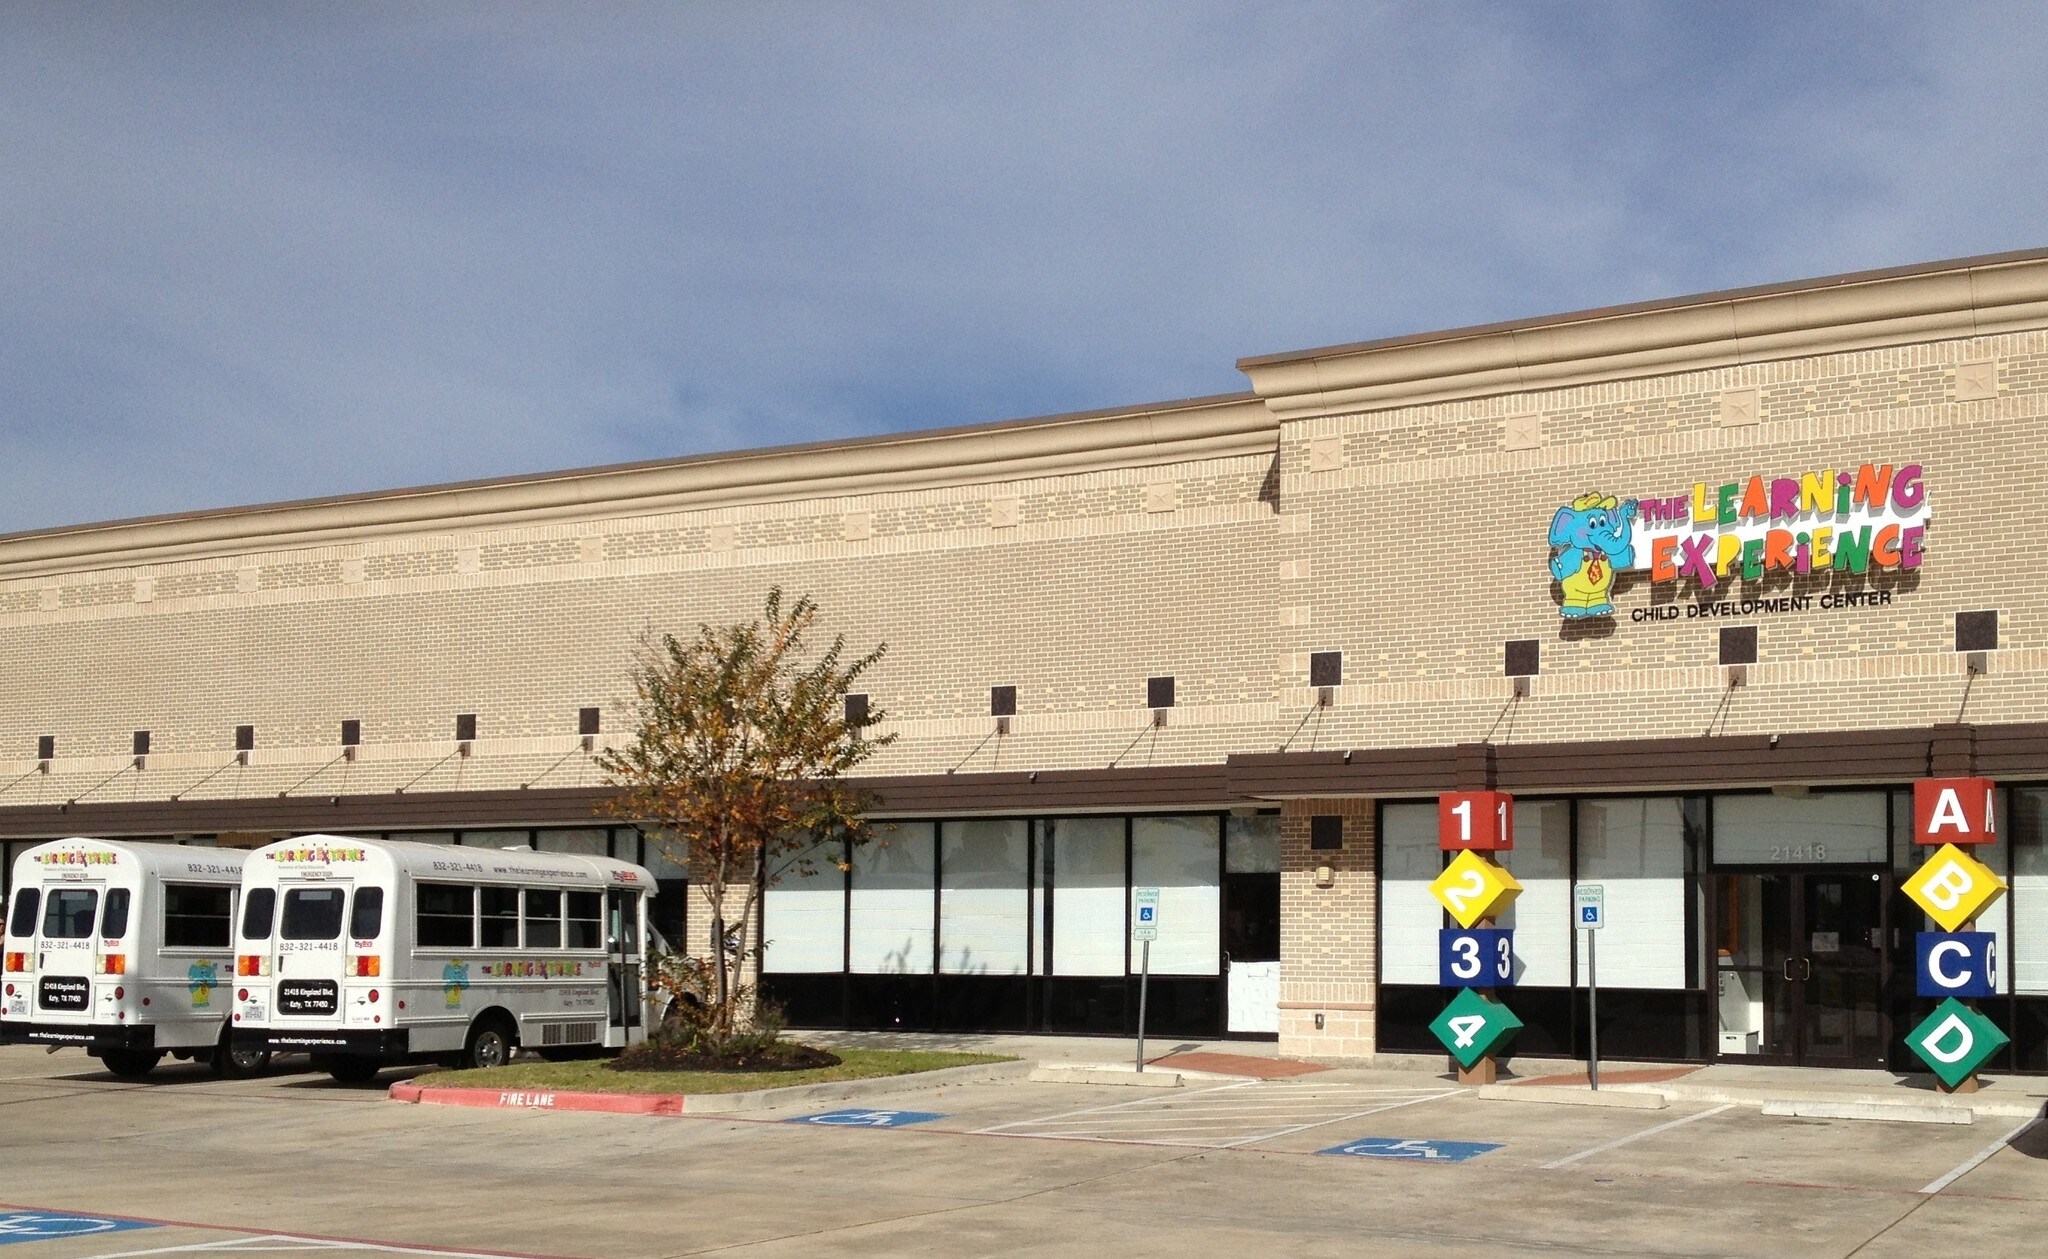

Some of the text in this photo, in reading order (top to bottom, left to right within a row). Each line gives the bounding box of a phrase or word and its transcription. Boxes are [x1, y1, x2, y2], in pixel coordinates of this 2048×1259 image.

[1638, 494, 1689, 524] THE
[1631, 590, 1892, 622] CHILD DEVELOPMENT CENTER
[1451, 800, 1471, 841] 1
[1498, 801, 1507, 841] 1
[1927, 788, 1970, 834] A
[1984, 788, 1996, 833] A
[433, 861, 483, 873] 832-321-4418
[1770, 844, 1826, 861] 21418
[1443, 869, 1486, 913] 2
[1920, 859, 1974, 912] B
[40, 941, 90, 950] 832-321-4418
[279, 942, 339, 951] 832-321-4418
[1451, 936, 1482, 979] 3
[1497, 937, 1511, 979] 3
[1928, 940, 1972, 988] C
[1985, 940, 1996, 989] C
[1447, 1014, 1487, 1049] 4
[1920, 1012, 1974, 1063] D
[499, 1093, 555, 1106] FIRE LANE
